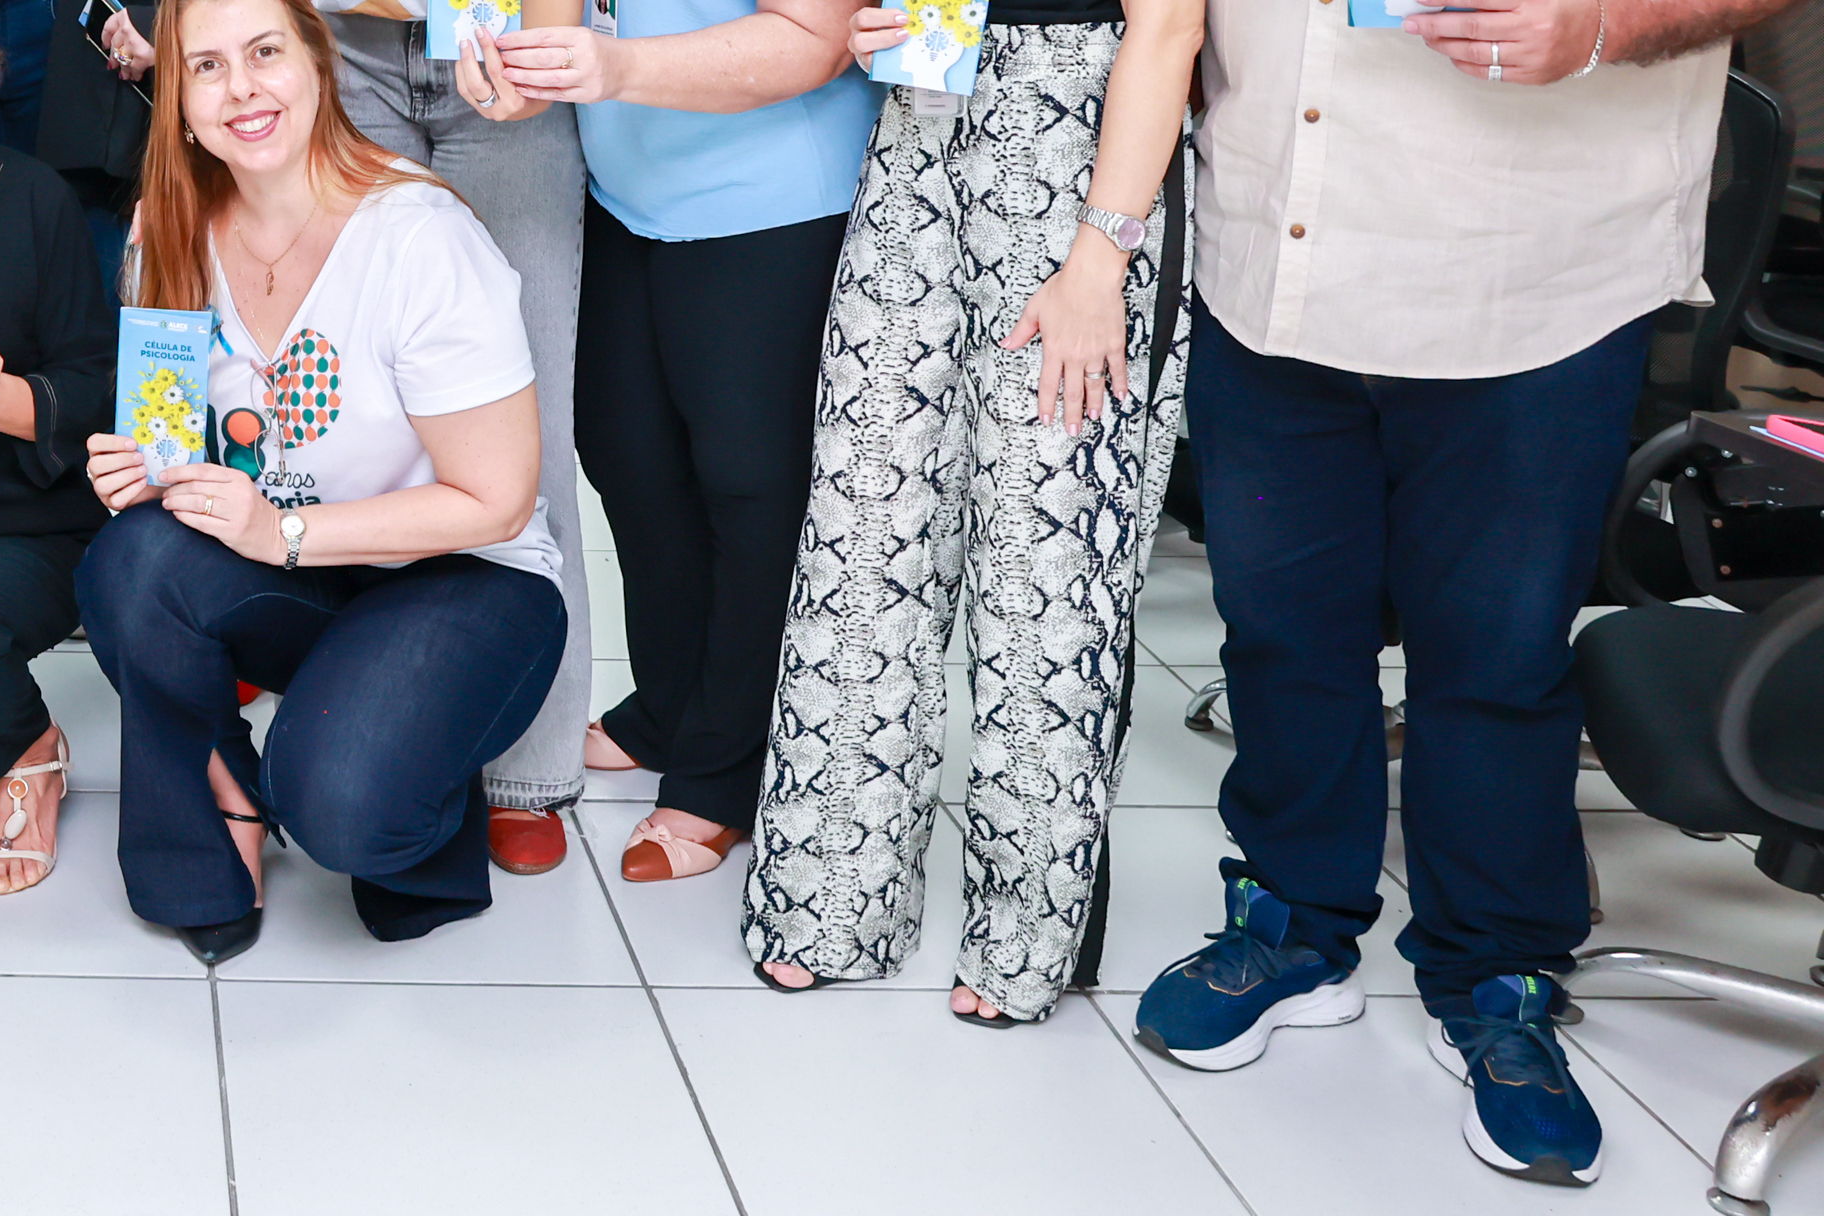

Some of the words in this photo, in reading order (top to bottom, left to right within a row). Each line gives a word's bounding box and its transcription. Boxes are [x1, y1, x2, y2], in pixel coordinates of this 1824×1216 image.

[145, 340, 178, 351] CÉLULA
[180, 344, 192, 352] DE
[141, 350, 195, 362] PSICOLOGIA
